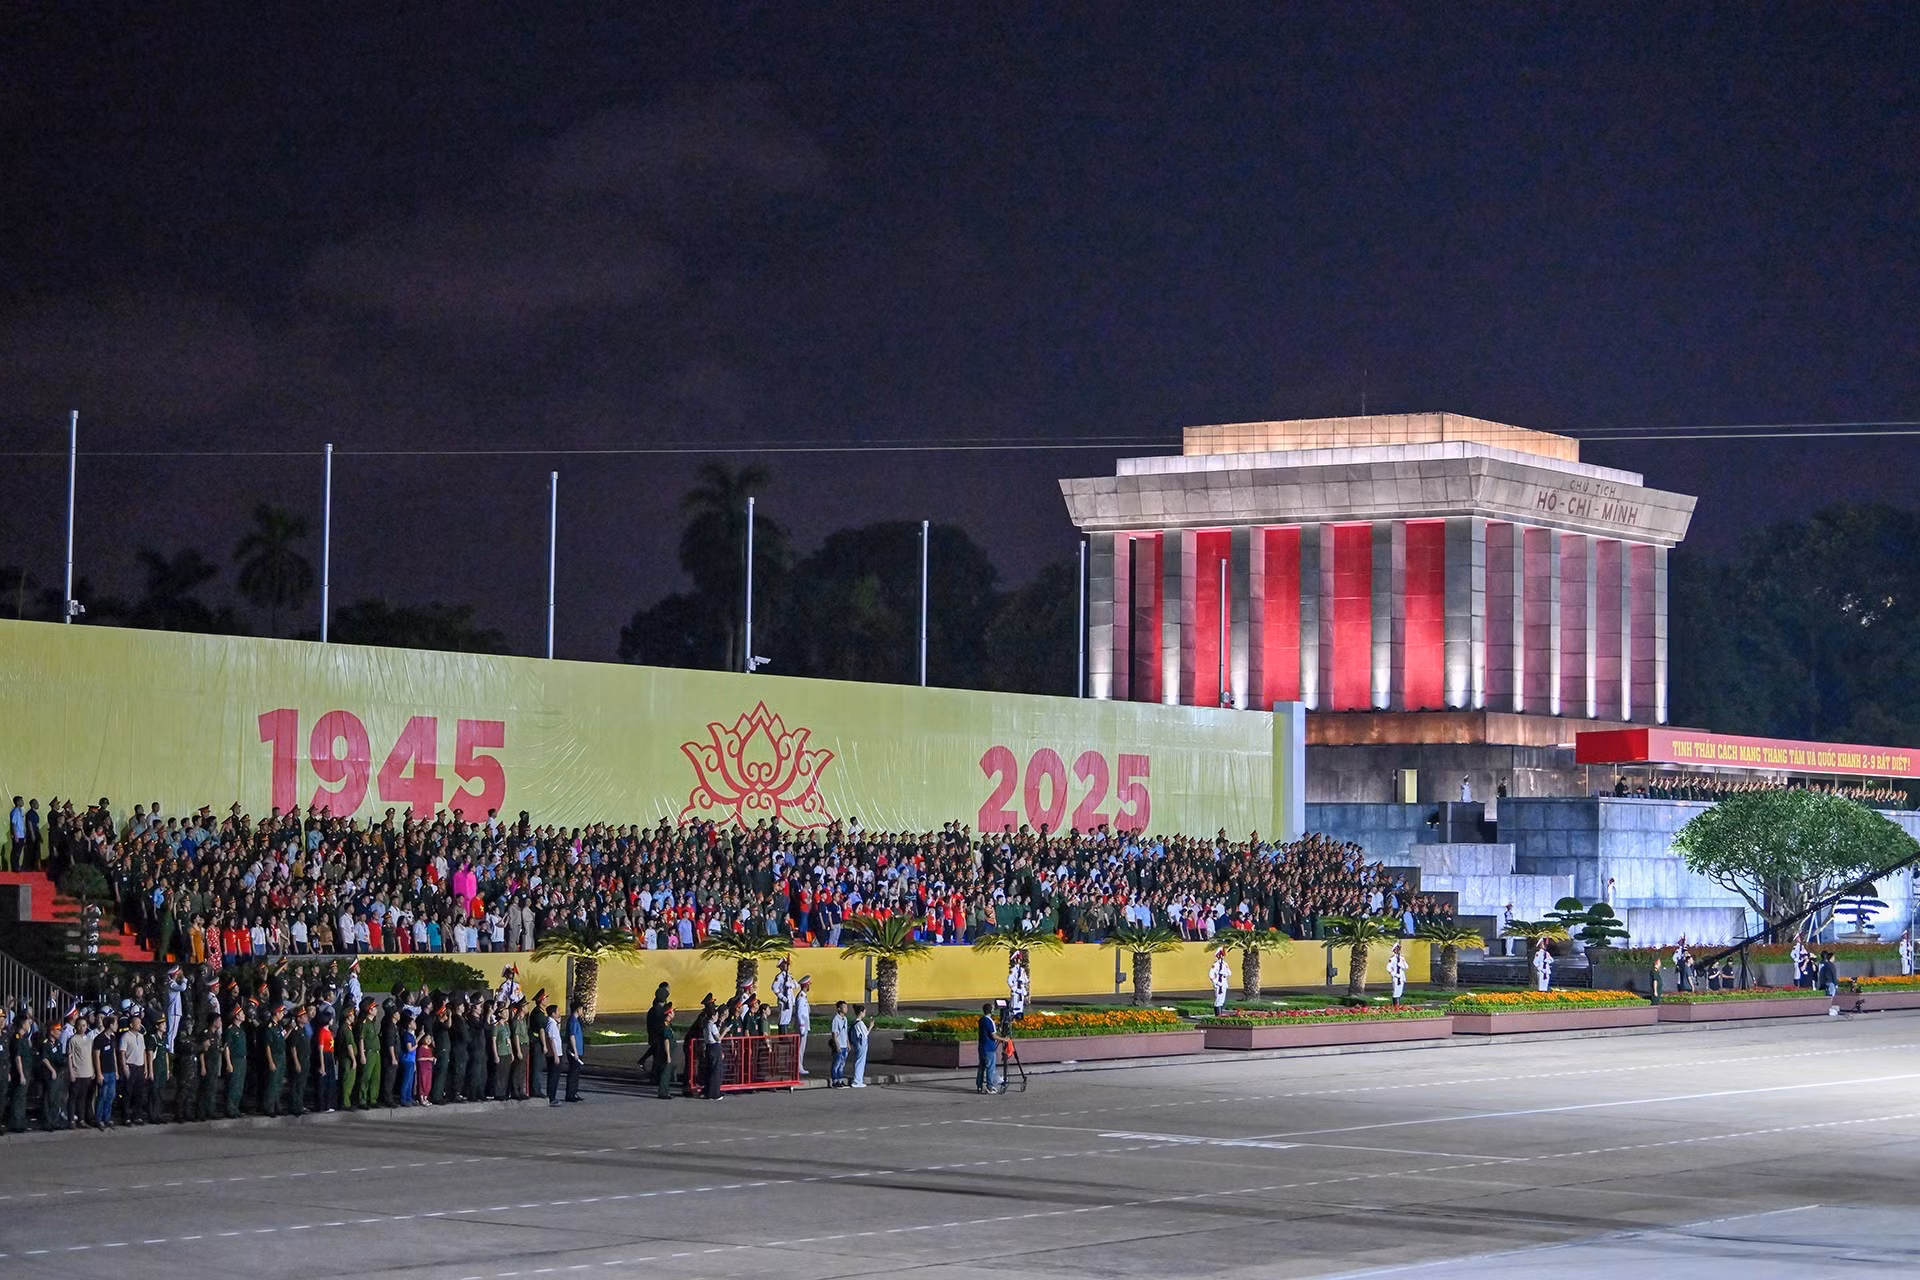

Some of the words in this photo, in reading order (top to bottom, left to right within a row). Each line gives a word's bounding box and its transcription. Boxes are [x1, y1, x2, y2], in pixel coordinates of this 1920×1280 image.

[258, 708, 506, 824] 1945
[978, 745, 1150, 836] 2025
[1672, 741, 1692, 757] TINH
[1717, 741, 1738, 760] CÁCH
[1740, 745, 1761, 765] MẠNG
[1762, 745, 1788, 764] THÁNG
[1789, 747, 1805, 765] TÁM
[1806, 748, 1816, 766] VÀ
[1817, 748, 1837, 768] QUỐC
[1837, 750, 1861, 769] KHÁNH
[1862, 754, 1876, 770] 2-9
[1876, 751, 1891, 770] BẤT
